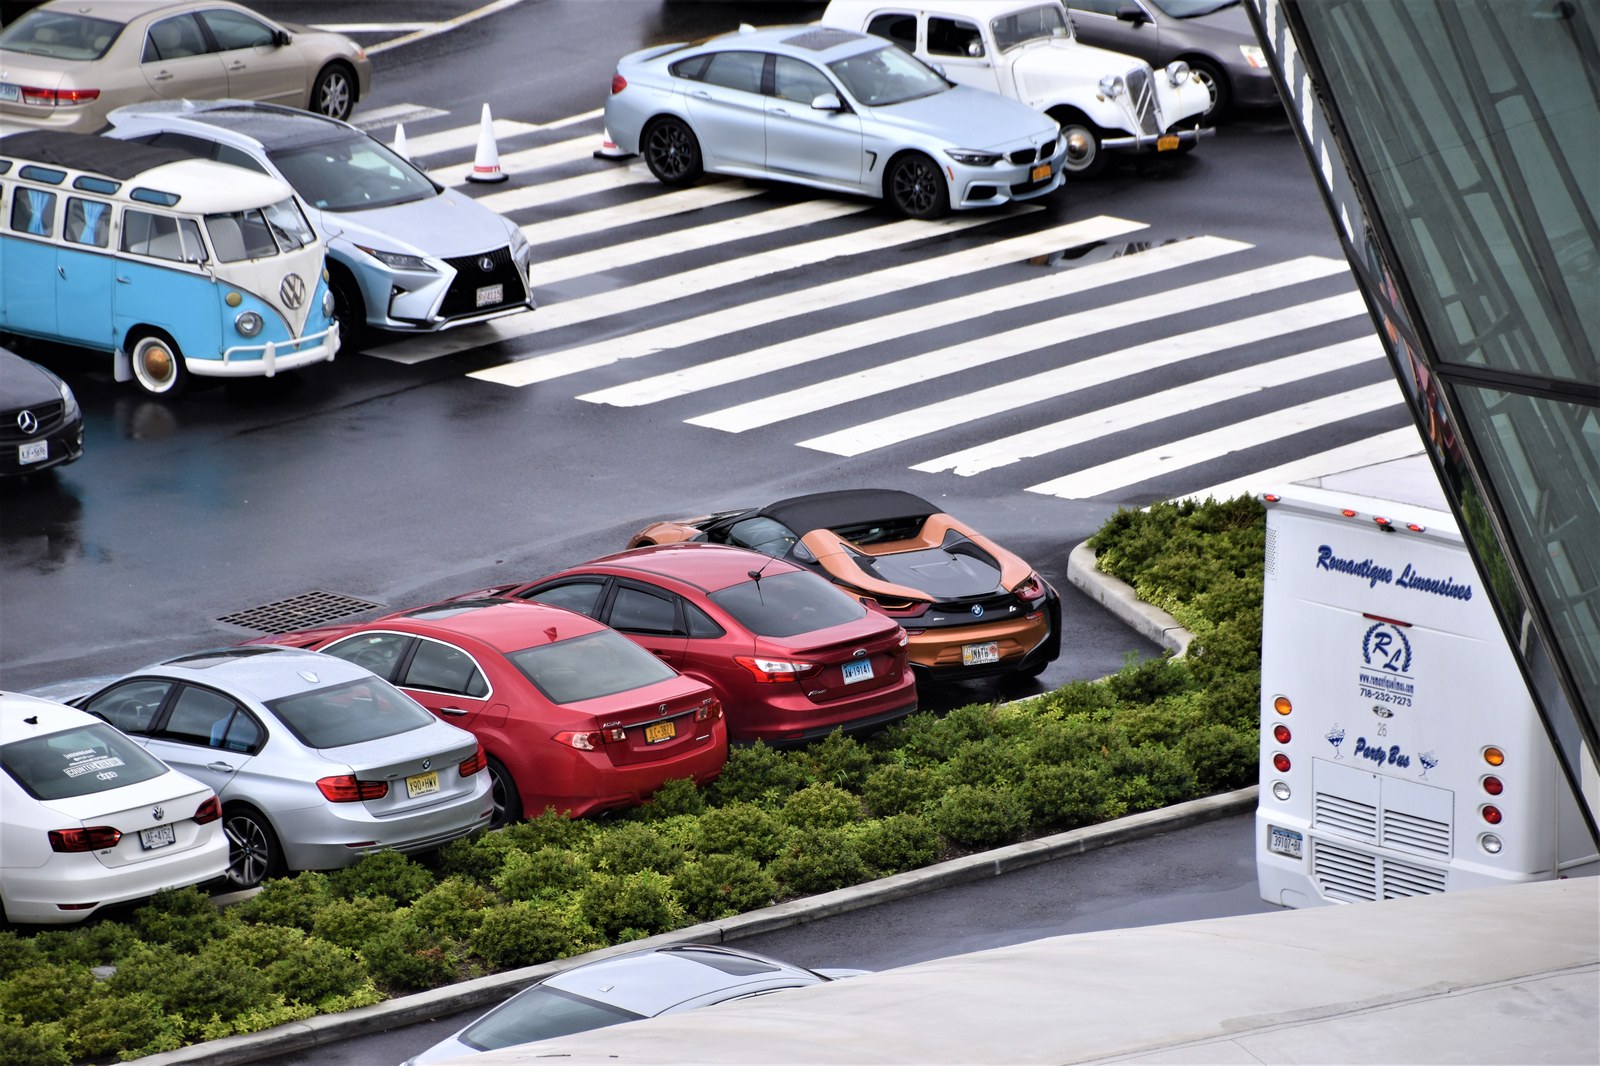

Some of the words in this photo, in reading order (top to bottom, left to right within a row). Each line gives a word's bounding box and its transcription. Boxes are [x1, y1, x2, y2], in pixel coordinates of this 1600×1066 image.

[1316, 545, 1393, 588] Romantique
[1395, 563, 1472, 601] Limousines
[1360, 687, 1412, 707] 718-232-7273
[1377, 722, 1387, 737] 26
[1354, 736, 1387, 767] Party
[1388, 745, 1410, 768] Bus
[65, 762, 98, 777] COUNTER
